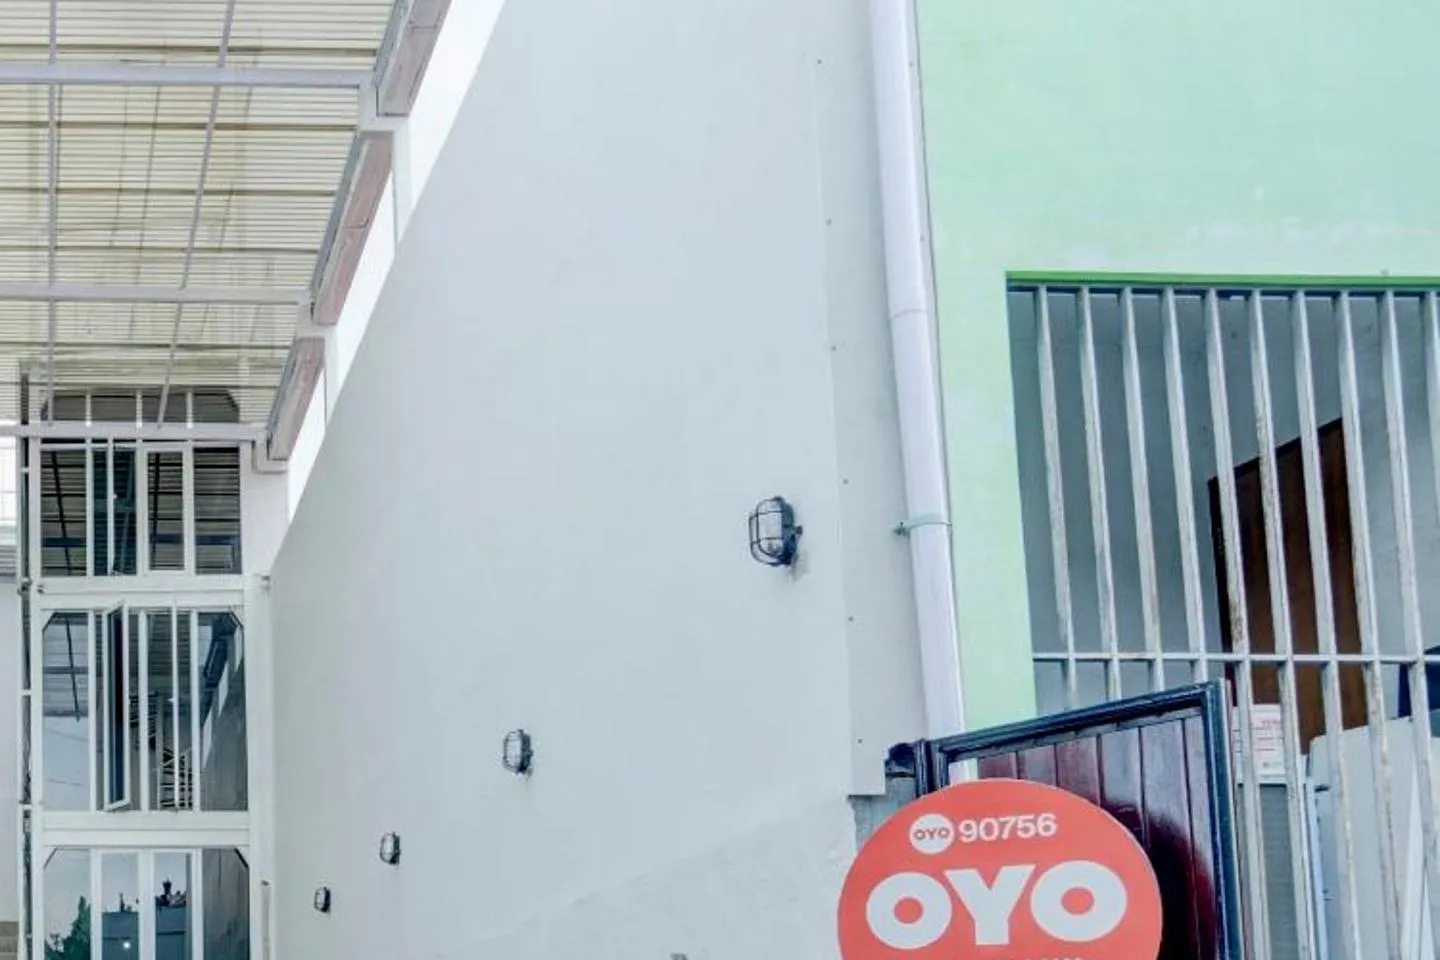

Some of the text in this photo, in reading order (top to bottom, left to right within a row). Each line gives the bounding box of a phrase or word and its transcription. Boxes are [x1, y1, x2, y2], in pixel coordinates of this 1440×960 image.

[913, 812, 1058, 843] OYO 90756
[866, 860, 1128, 949] OYO
